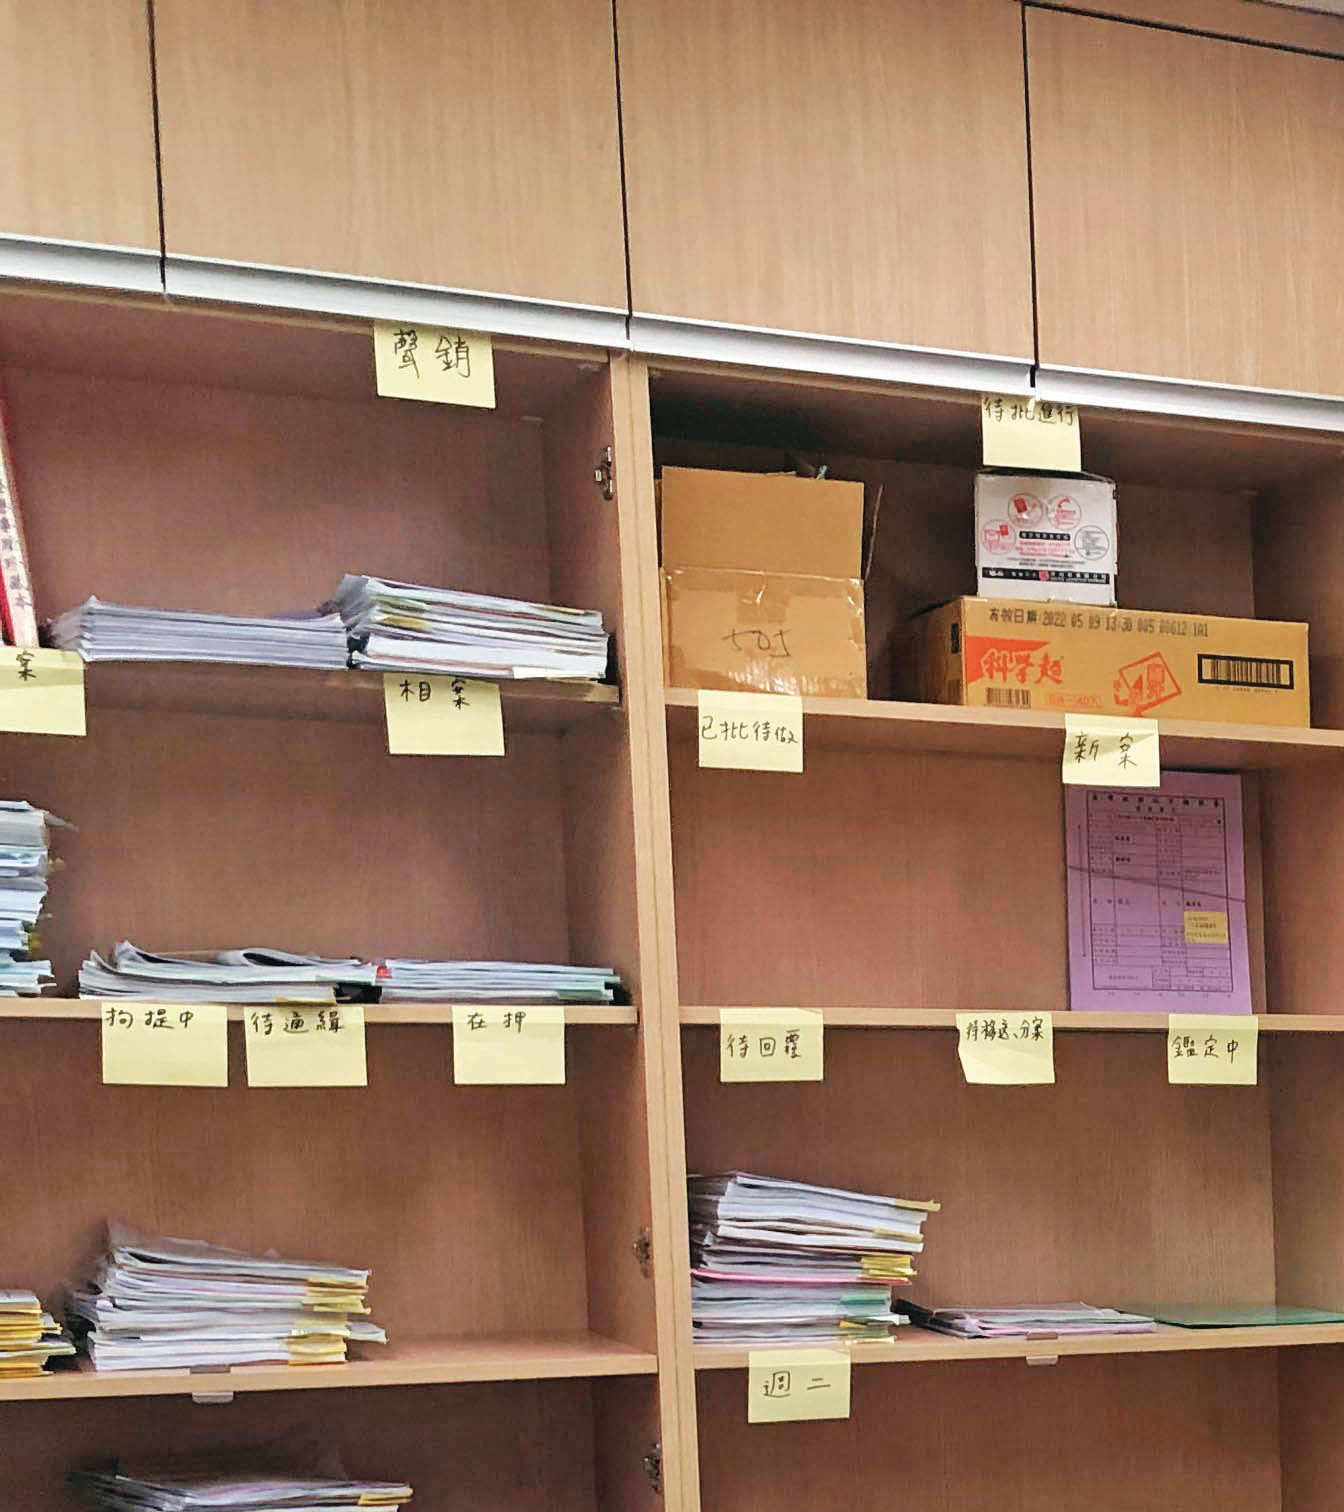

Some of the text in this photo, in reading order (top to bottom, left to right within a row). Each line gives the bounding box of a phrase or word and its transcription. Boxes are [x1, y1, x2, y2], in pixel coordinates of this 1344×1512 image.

[1074, 732, 1138, 769] 新案
[1171, 1034, 1239, 1065] 鑑定中
[762, 1369, 832, 1399] 週二
